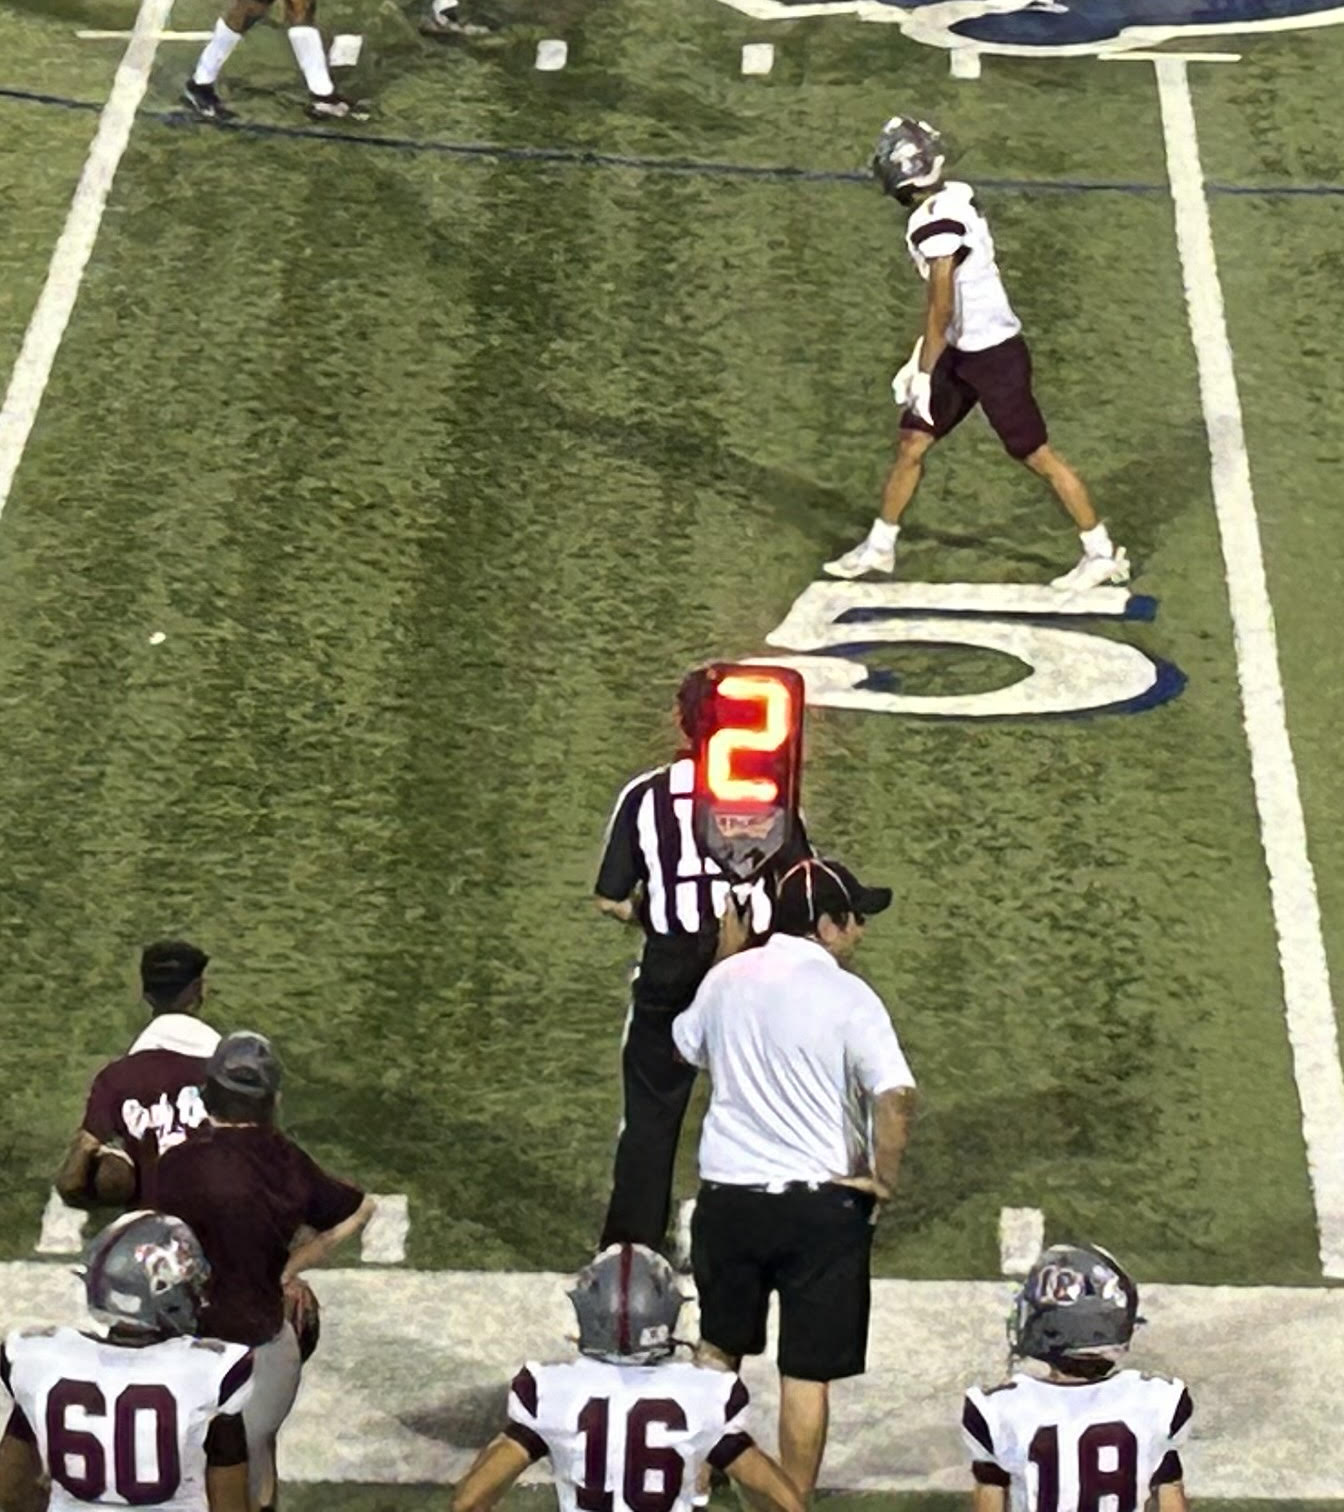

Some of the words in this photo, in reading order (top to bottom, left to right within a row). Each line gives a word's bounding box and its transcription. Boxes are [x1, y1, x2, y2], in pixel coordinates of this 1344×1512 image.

[707, 674, 792, 804] 2
[47, 1378, 182, 1506] 60
[577, 1395, 688, 1512] 16
[1029, 1420, 1140, 1512] 18
